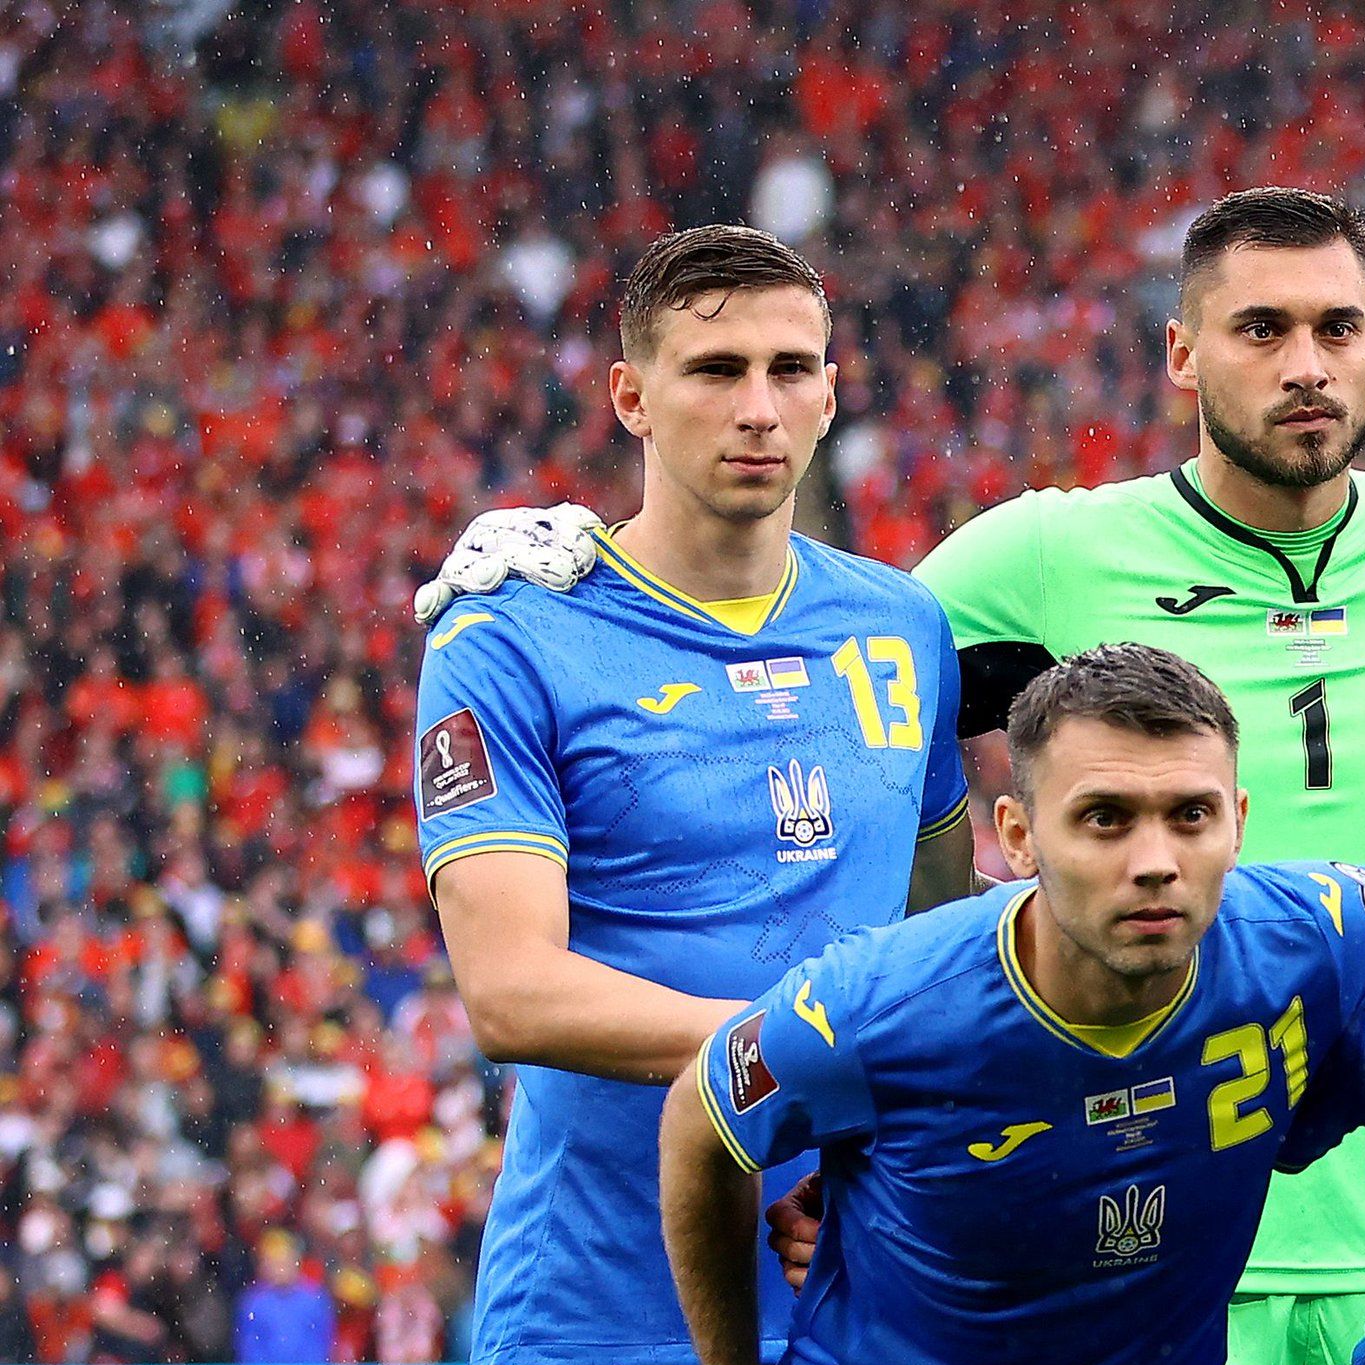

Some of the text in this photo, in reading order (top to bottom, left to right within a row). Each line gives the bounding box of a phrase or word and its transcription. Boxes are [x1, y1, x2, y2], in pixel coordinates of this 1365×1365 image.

[831, 635, 923, 750] 13
[1289, 677, 1333, 790] 1
[777, 847, 838, 863] UKRAINE
[1201, 995, 1309, 1152] 21
[1093, 1254, 1158, 1267] UKRAINE
